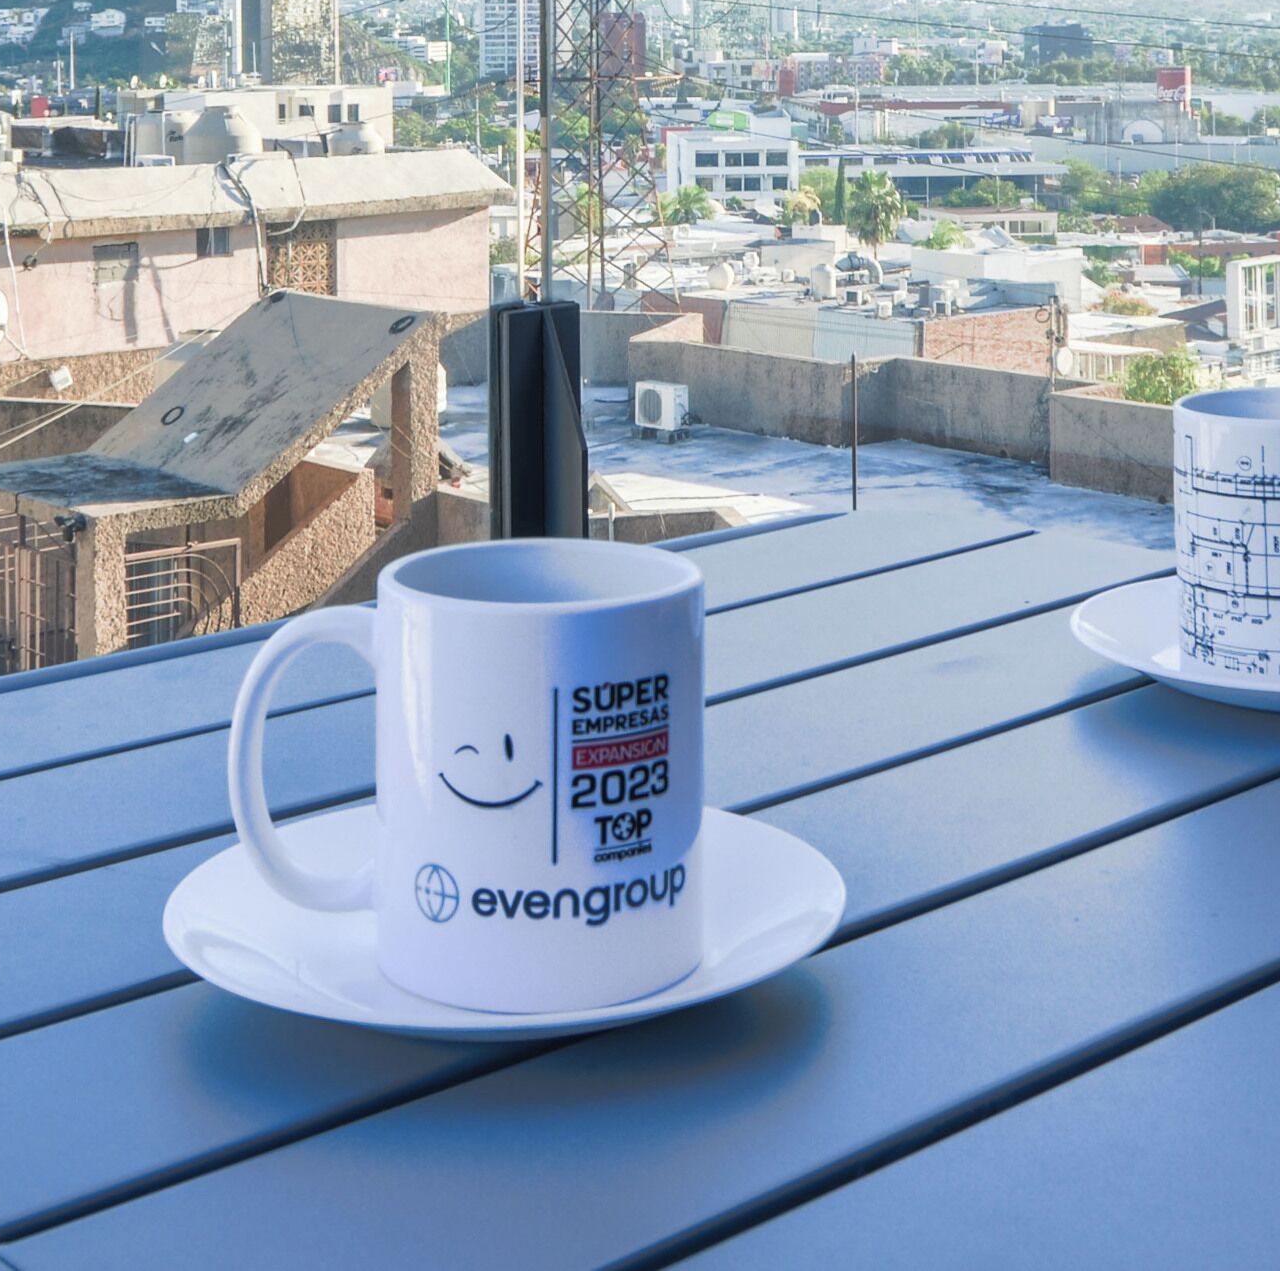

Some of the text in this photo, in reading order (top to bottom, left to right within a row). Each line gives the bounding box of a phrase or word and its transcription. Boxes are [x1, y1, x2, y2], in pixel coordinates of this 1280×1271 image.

[572, 673, 669, 714] SÚPER
[572, 704, 669, 736] EMPRESAS
[571, 757, 669, 809] 2023
[594, 808, 653, 846] TOP
[471, 863, 686, 927] evengroup
